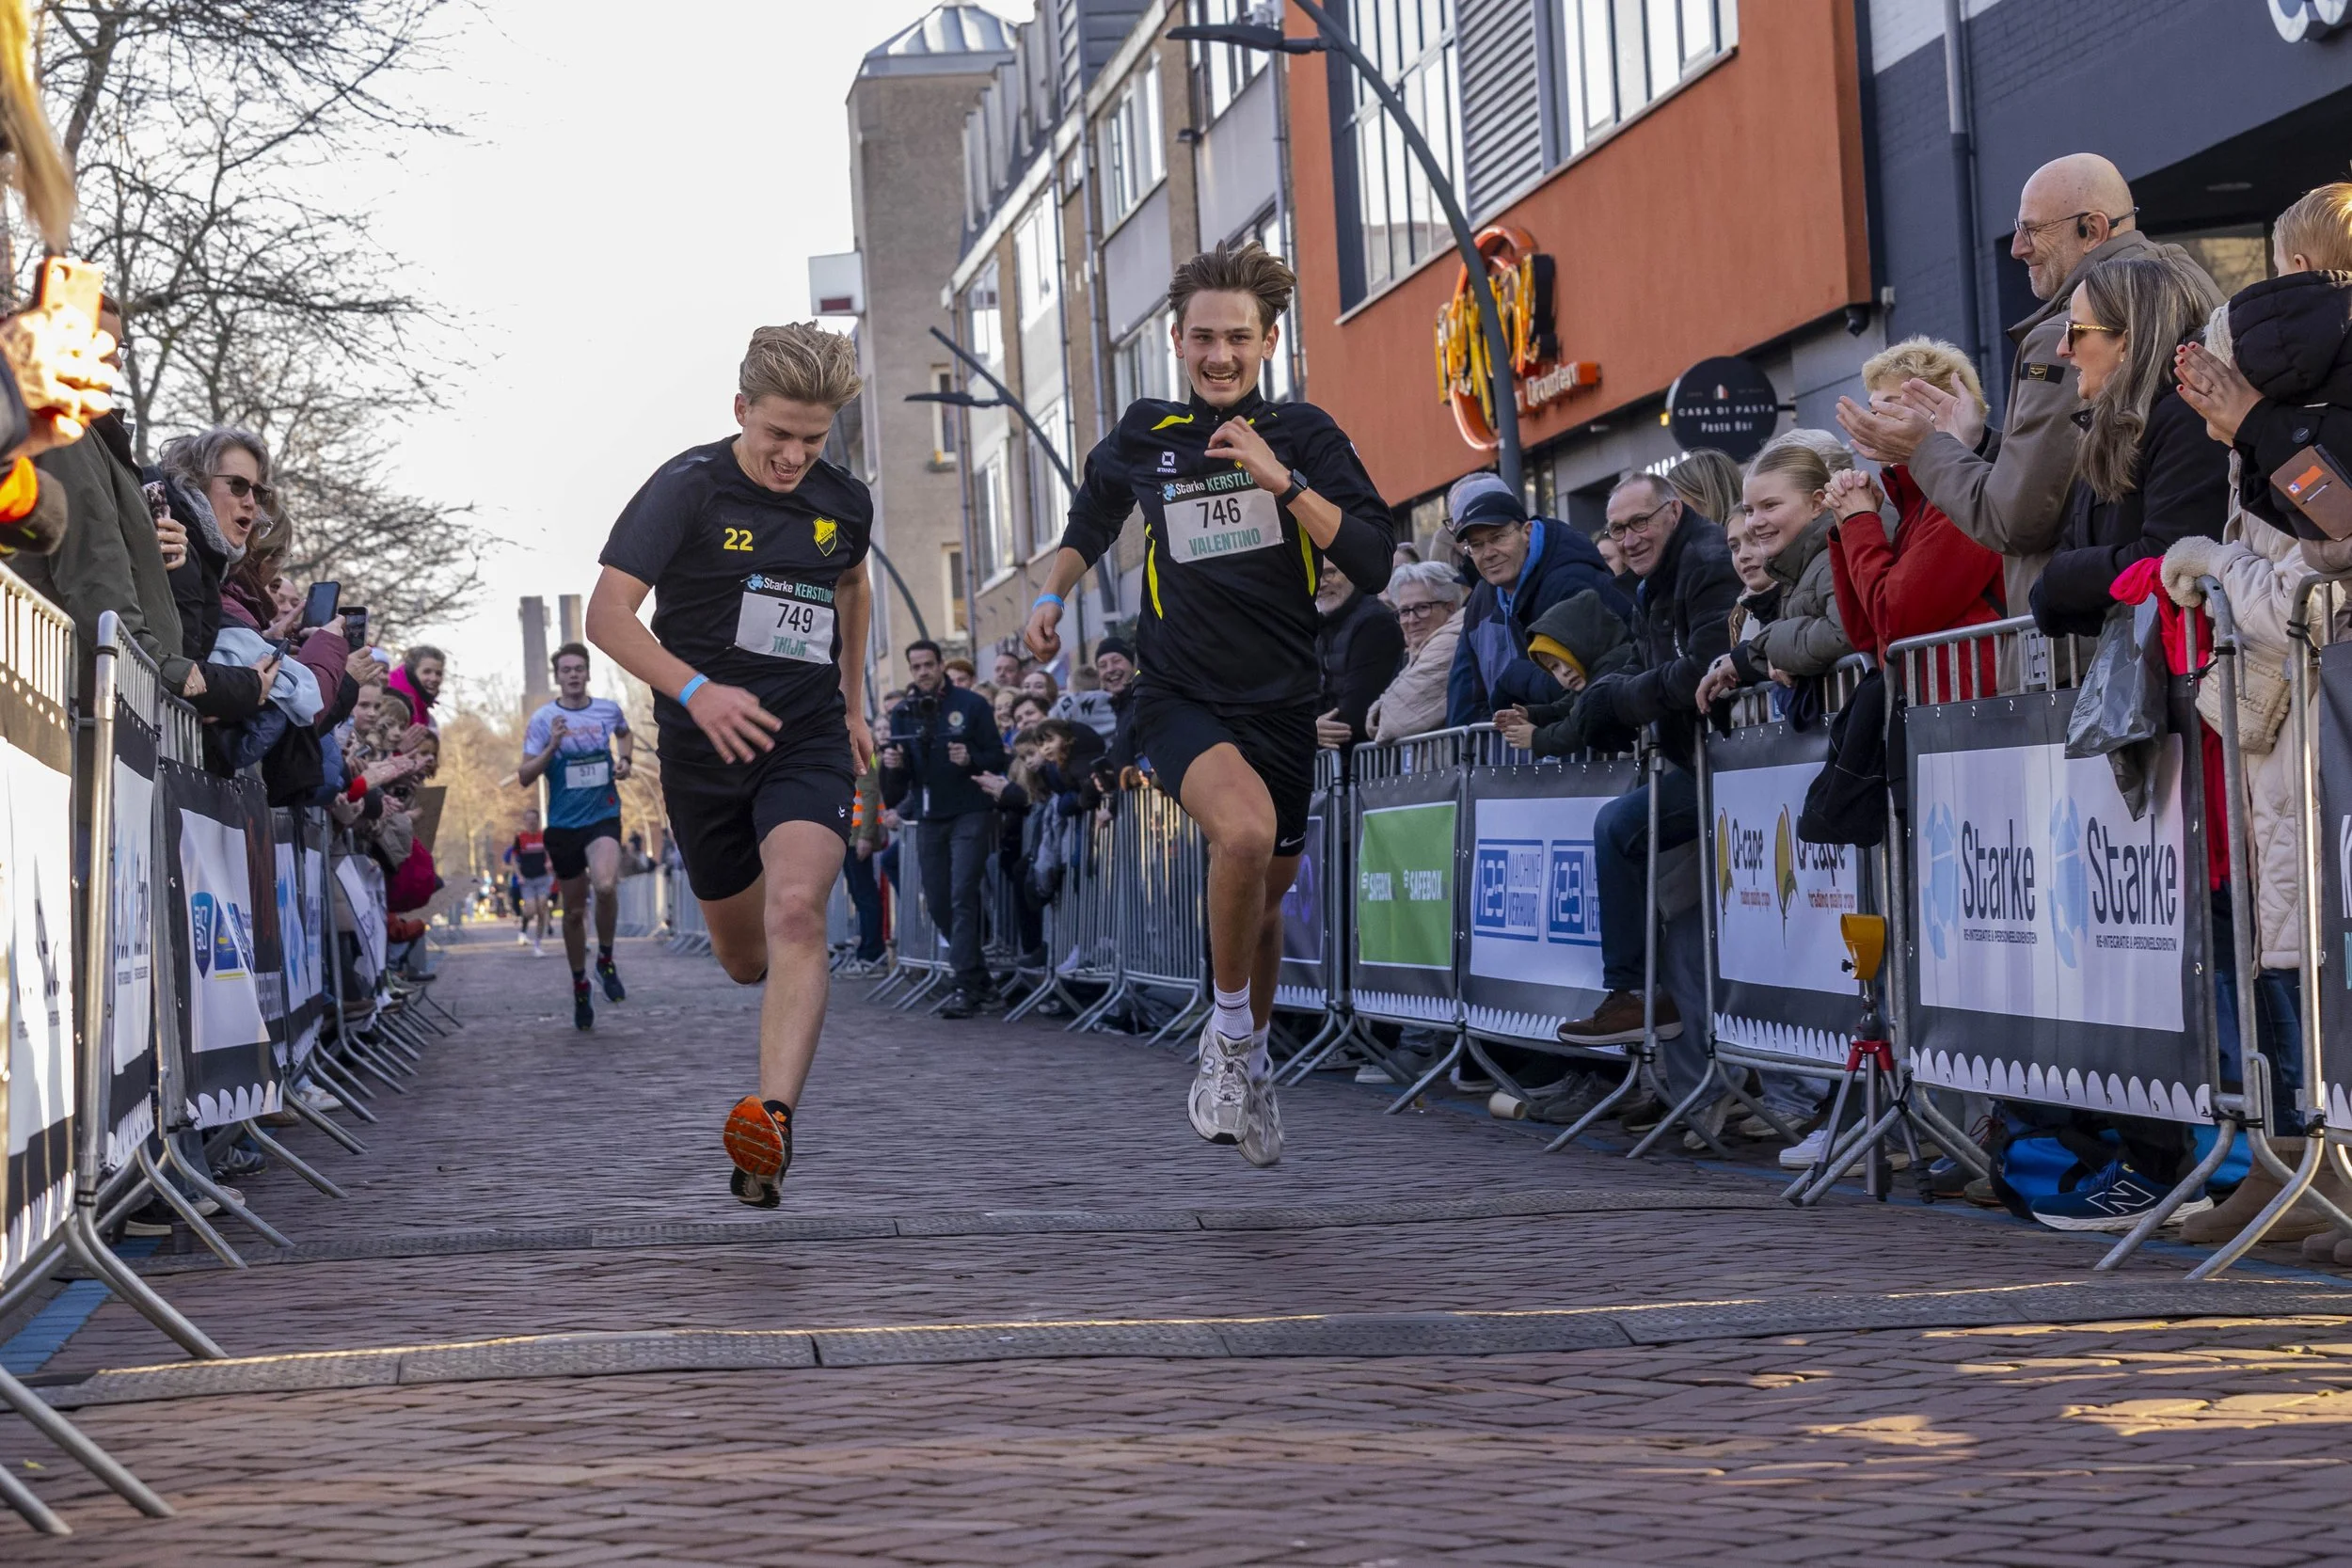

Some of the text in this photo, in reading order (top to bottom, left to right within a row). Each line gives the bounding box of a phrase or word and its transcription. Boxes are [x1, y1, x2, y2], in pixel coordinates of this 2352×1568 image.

[1677, 404, 1774, 417] CASA DI PASTA
[1701, 421, 1731, 433] Pasta
[1175, 471, 1253, 495] Starke KERSTLO
[1196, 497, 1241, 529] 746
[723, 527, 754, 551] 22
[1189, 527, 1262, 556] VALENTINO
[764, 577, 794, 594] Starke
[776, 602, 814, 634] 749
[1962, 818, 2036, 921] Starke
[2087, 814, 2177, 926] Starke
